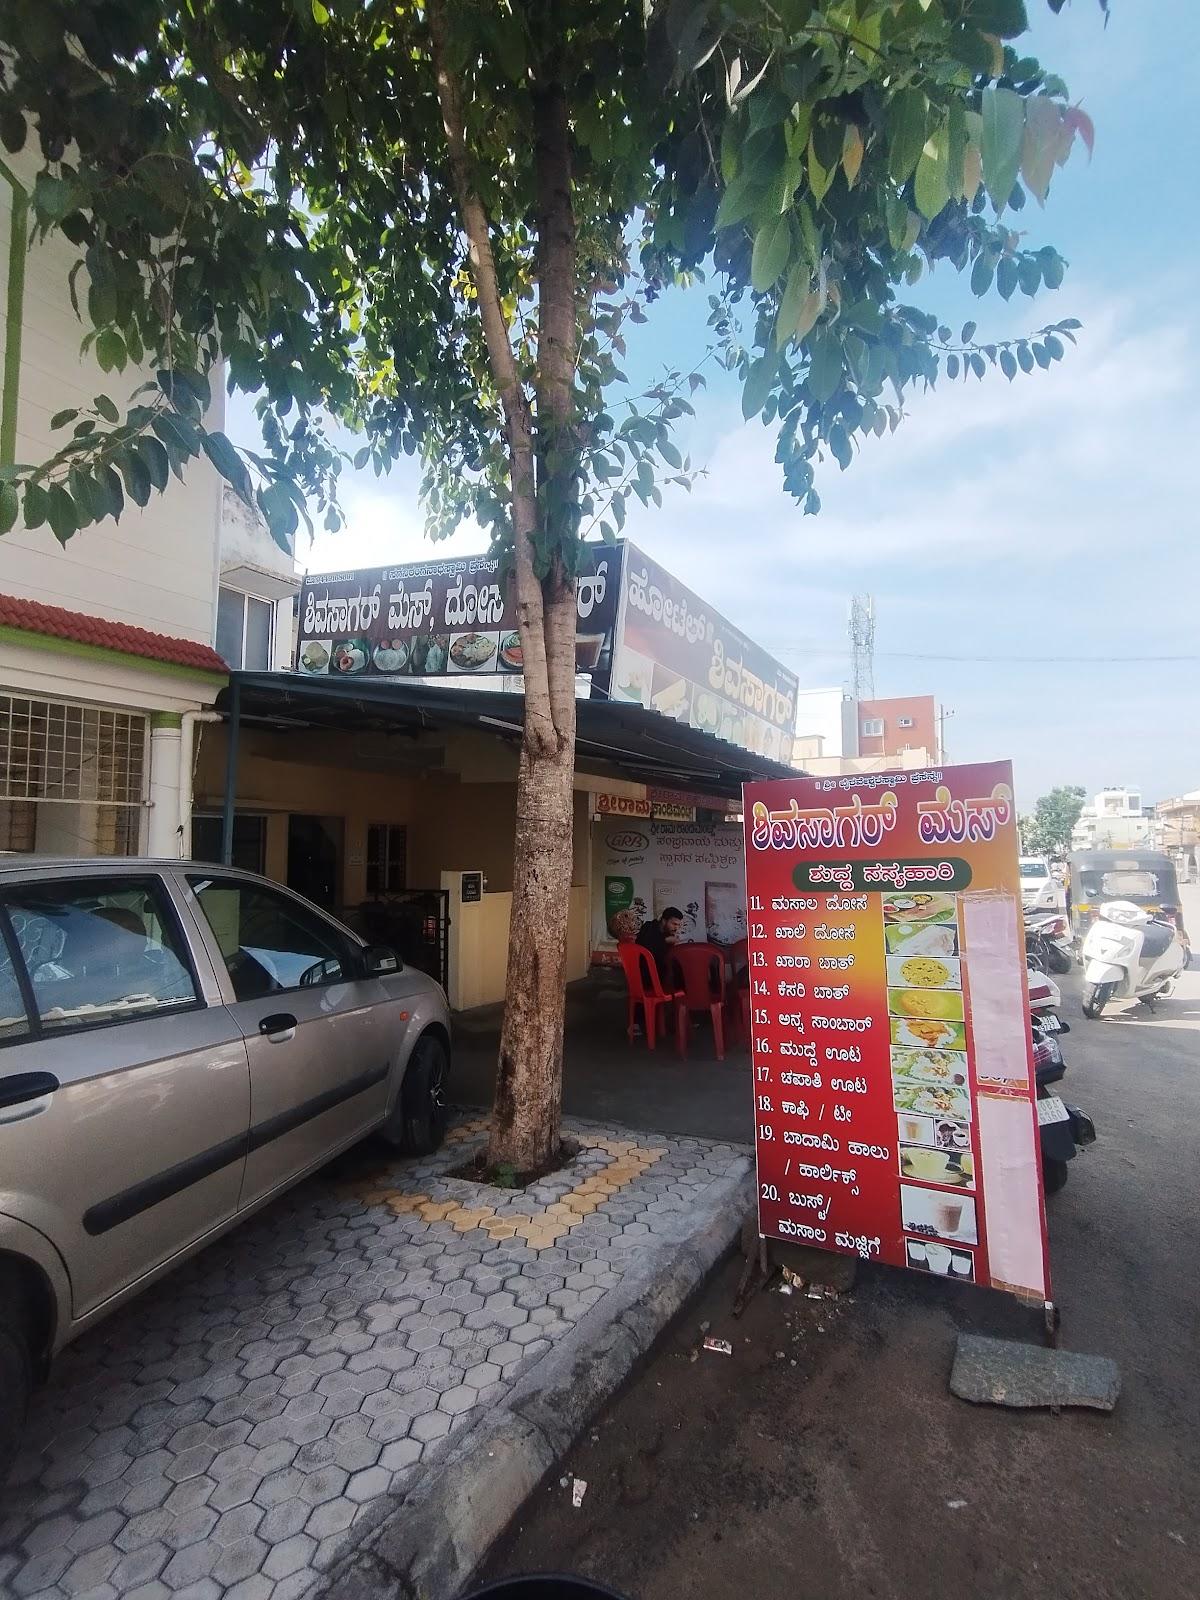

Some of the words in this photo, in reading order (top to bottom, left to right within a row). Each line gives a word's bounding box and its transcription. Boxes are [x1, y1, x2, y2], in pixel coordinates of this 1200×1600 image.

[303, 584, 381, 634] ಶಿವಸಾಗರ್
[444, 574, 505, 626] ದೋಸ
[708, 638, 793, 725] ಶಿವಸಾಗರ್
[752, 791, 898, 850] ಶಿವಸಾಗರ್
[917, 783, 1013, 844] ಮೆಸ್
[863, 862, 955, 889] ಸಸ್ಯಹಾರಿ
[750, 895, 764, 910] 11.
[771, 896, 818, 910] ಮಸಾಲ
[826, 894, 868, 910] ದೋಸೆ
[751, 924, 767, 938] 12.
[775, 924, 806, 939] ಖಾಲಿ
[814, 924, 855, 940] ದೋಸೆ
[752, 952, 768, 967] 13.
[775, 955, 811, 969] ಖಾರಾ
[818, 954, 855, 970] ಬಾತ್
[753, 980, 770, 996] 14.
[778, 981, 806, 998] ಕೆಸರಿ
[813, 984, 850, 1000] ಬಾತ್
[754, 1009, 771, 1024] 15.
[778, 1012, 805, 1034] ಅನ್ನ
[811, 1015, 872, 1032] ಸಾಂಬಾರ್
[755, 1038, 773, 1053] 16.
[780, 1040, 818, 1066] ಮುದ್ದೆ
[825, 1045, 861, 1062] ಊಟ
[756, 1067, 773, 1082] 17.
[780, 1070, 823, 1088] ಚಪಾತಿ
[830, 1077, 867, 1094] ಊಟ
[758, 1095, 774, 1111] 18.
[781, 1100, 810, 1120] ಕಾಫಿ
[833, 1104, 852, 1122] ಟೀ
[759, 1124, 776, 1141] 19.
[783, 1131, 840, 1151] ಬಾದಾಮಿ
[847, 1141, 890, 1160] ಹಾಲು
[761, 1183, 781, 1202] 20.
[778, 1218, 827, 1242] ಮಸಾಲ
[834, 1230, 881, 1260] ಮಜ್ಜಿಗೆ
